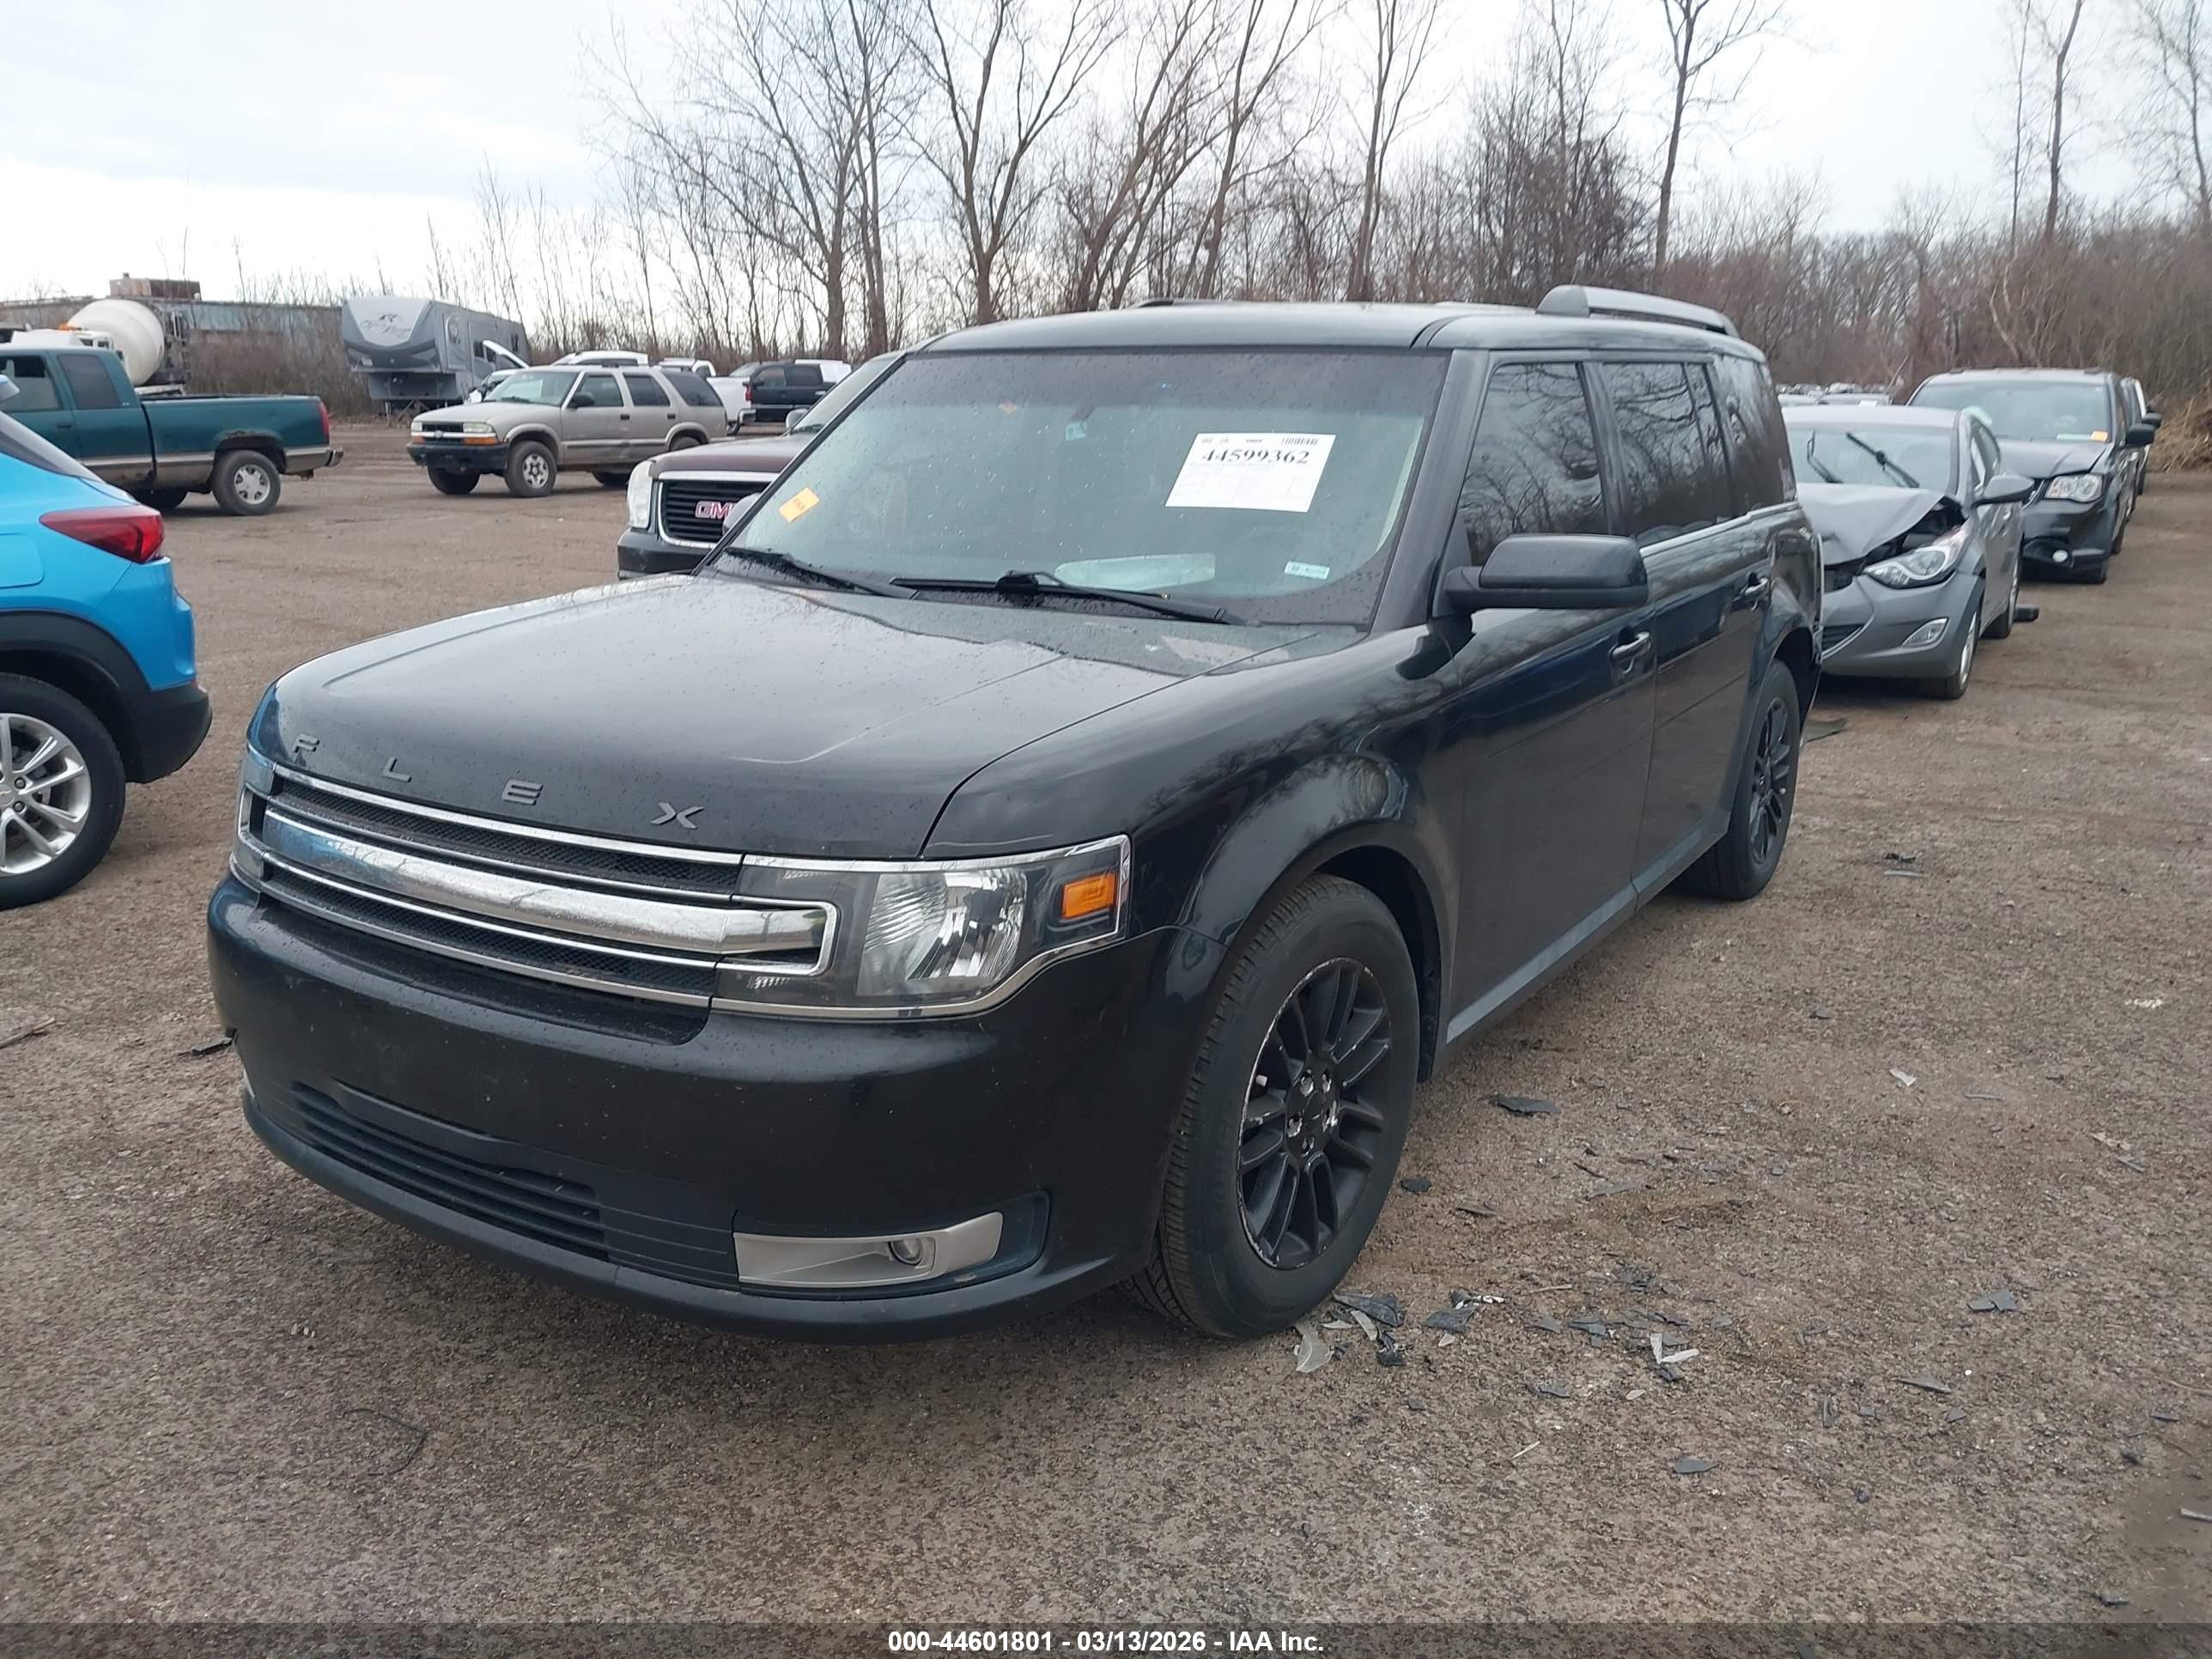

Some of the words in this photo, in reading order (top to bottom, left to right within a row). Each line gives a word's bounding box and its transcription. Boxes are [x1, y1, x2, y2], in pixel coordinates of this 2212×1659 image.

[1201, 449, 1310, 465] 44599362
[696, 501, 735, 520] GM
[292, 732, 704, 830] FLEX
